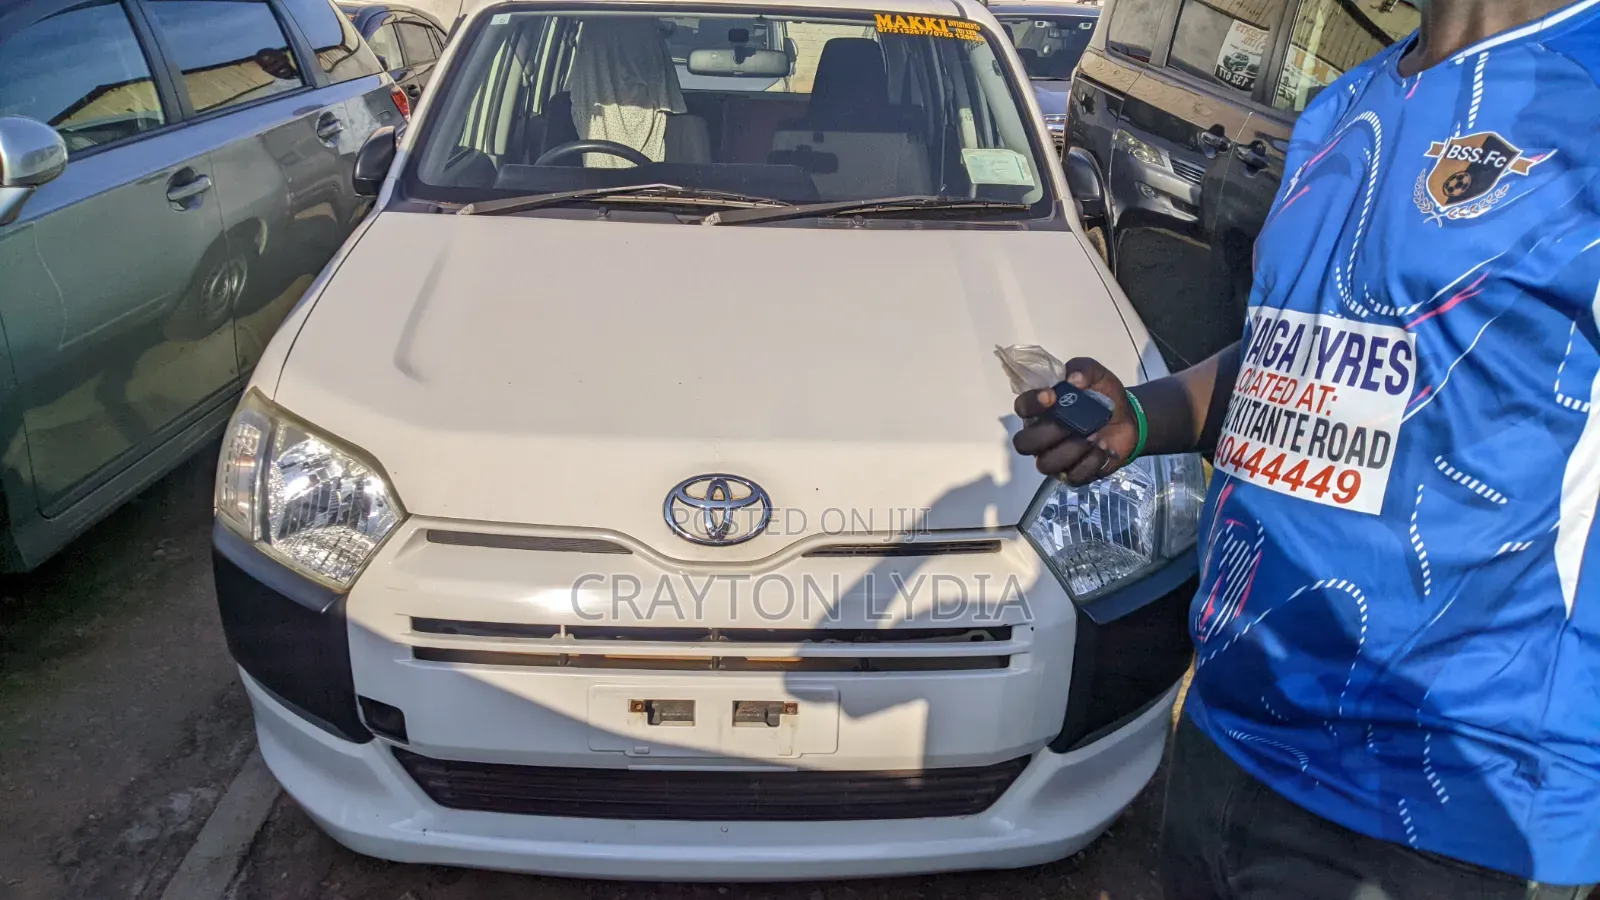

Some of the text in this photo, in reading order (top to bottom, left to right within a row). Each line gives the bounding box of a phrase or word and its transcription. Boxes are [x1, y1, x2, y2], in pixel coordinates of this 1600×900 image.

[874, 14, 948, 32] MAKKI
[1301, 325, 1413, 396] TYRES
[1235, 367, 1339, 416] OCATED AT:
[1230, 396, 1310, 454] KITANTE
[1307, 417, 1392, 470] ROAD
